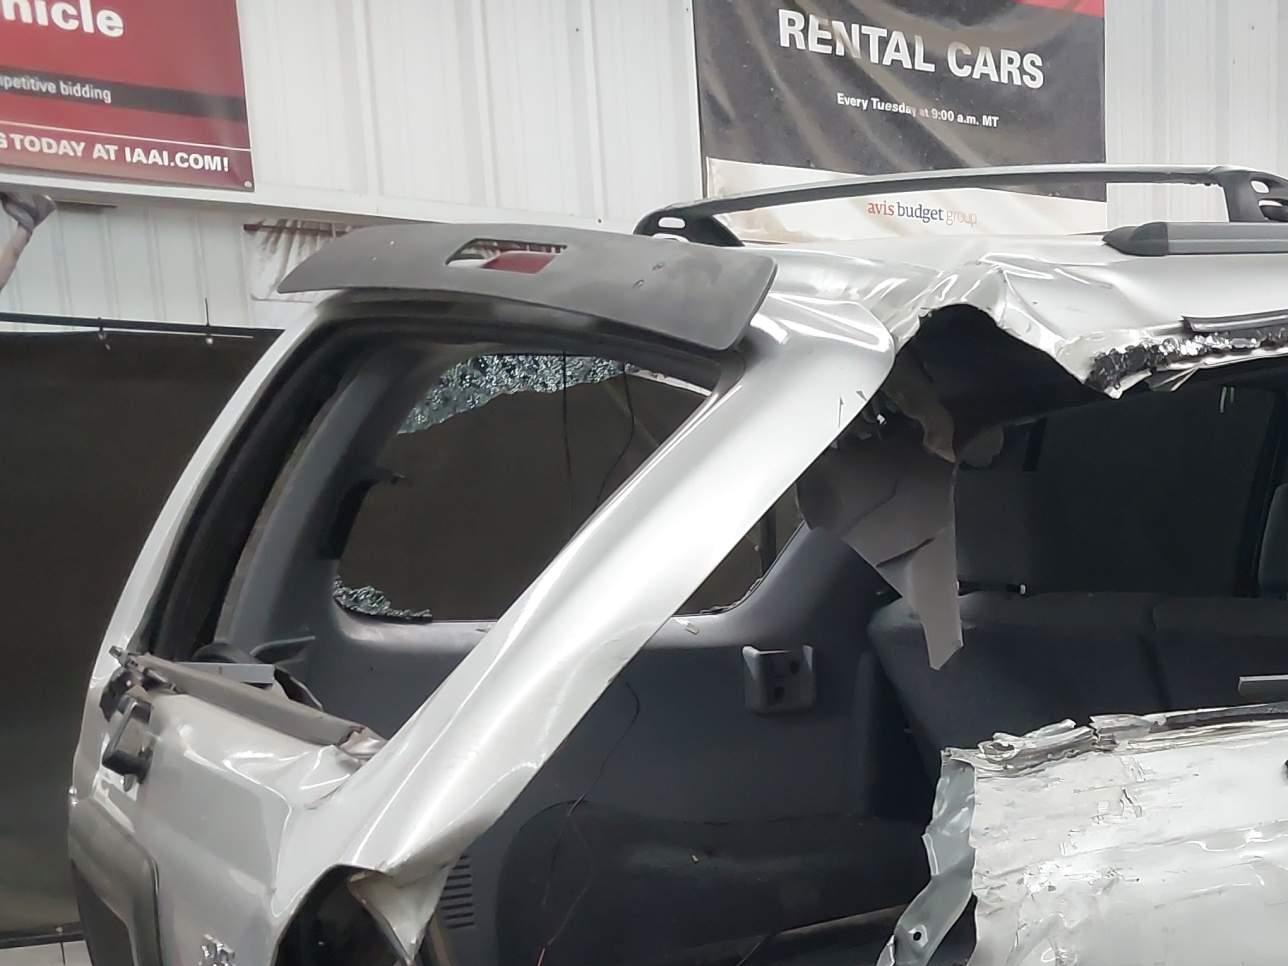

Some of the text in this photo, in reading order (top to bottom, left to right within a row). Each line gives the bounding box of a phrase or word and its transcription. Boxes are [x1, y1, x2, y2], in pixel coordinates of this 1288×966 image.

[778, 9, 1044, 89] RENTAL CARS
[60, 80, 112, 104] bidding
[836, 92, 1000, 127] Every Tuesday at 9:00 a.m. MT
[9, 133, 86, 157] TODAY
[92, 143, 119, 161] AT
[124, 146, 230, 172] IAAI.COM!
[867, 200, 978, 227] avis budget group
